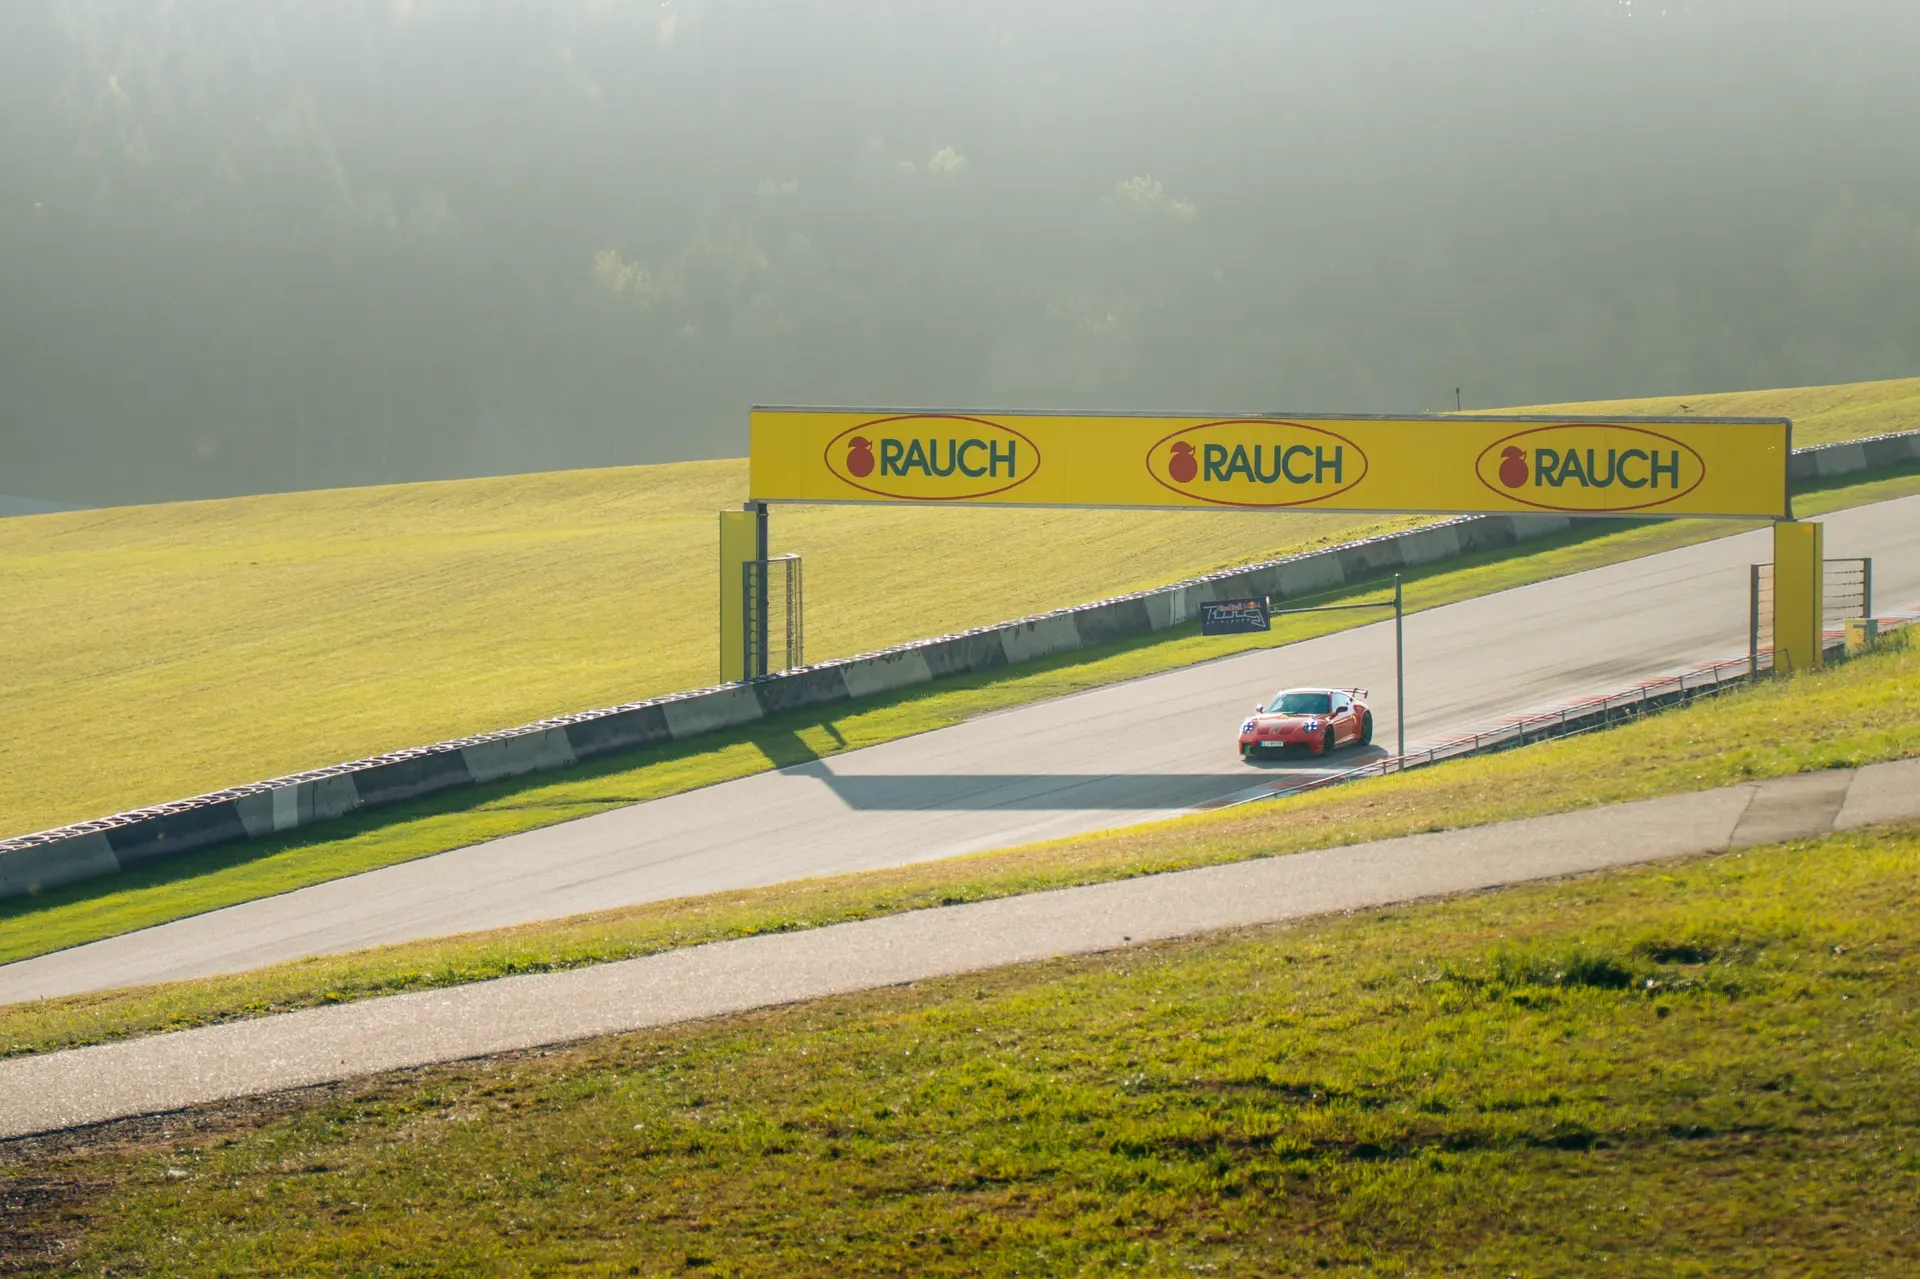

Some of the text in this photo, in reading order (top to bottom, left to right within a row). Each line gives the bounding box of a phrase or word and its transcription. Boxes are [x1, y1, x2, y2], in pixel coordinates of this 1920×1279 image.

[881, 439, 1016, 477] RAUCH
[1205, 444, 1342, 483] RAUCH
[1535, 449, 1679, 489] RAUCH
